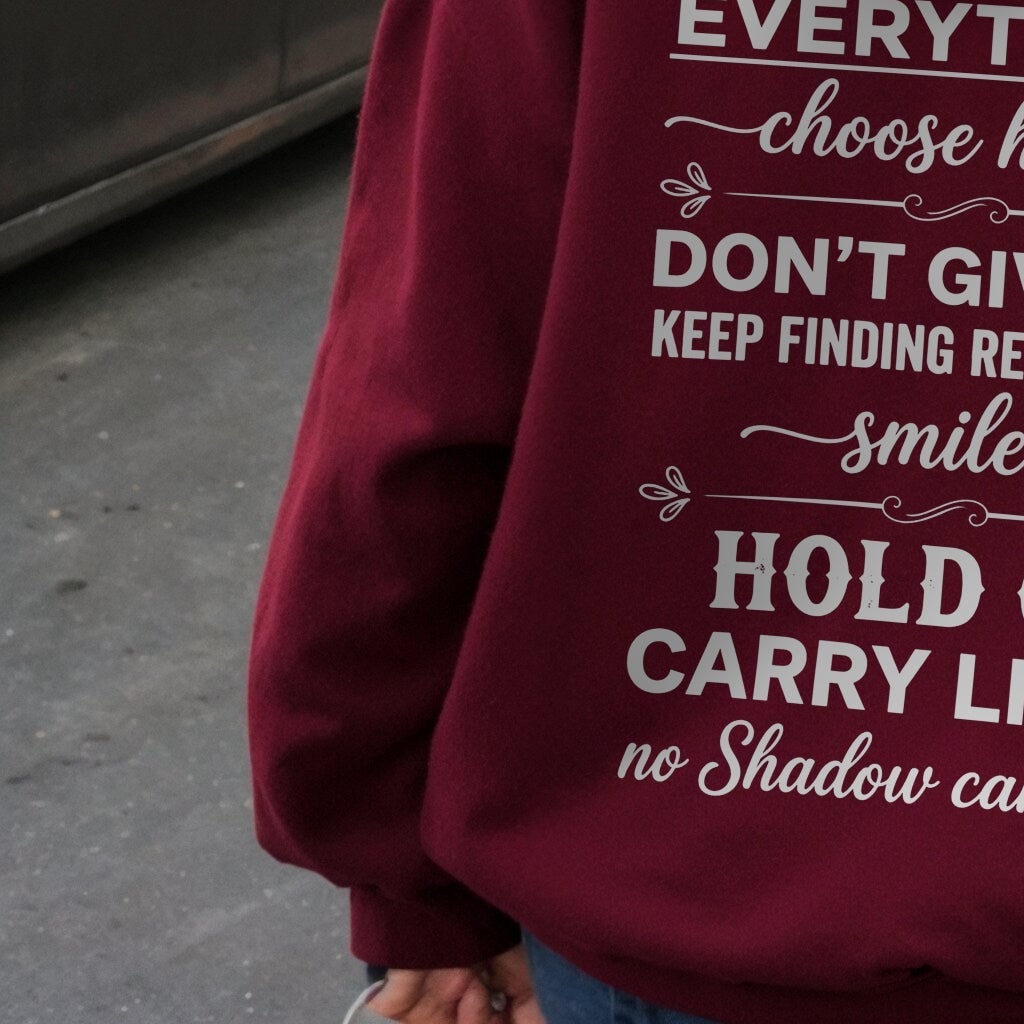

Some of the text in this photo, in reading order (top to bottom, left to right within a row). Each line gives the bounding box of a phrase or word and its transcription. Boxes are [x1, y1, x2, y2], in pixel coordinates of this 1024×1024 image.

[758, 77, 984, 174] choose
[652, 229, 906, 300] DON’T
[651, 309, 764, 361] KEEP
[778, 315, 955, 375] FINDING
[709, 530, 986, 628] HOLD
[626, 628, 932, 714] CARRY
[617, 742, 690, 782] no
[697, 719, 941, 805] Shadow
